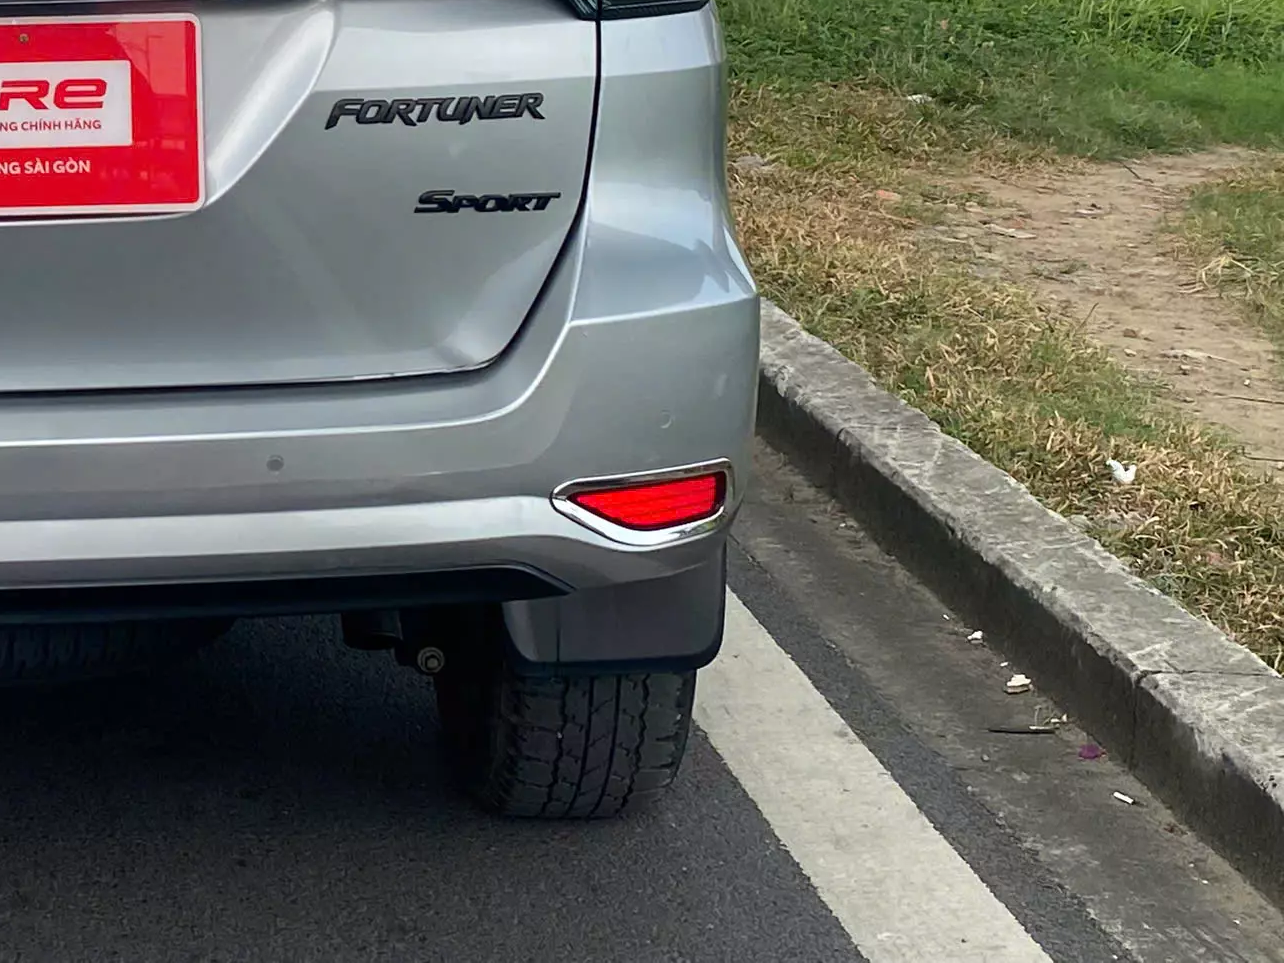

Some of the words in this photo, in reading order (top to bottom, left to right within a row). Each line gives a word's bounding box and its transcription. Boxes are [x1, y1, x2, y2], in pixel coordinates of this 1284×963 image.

[324, 92, 546, 130] FORTUNER
[20, 118, 61, 132] CHÍNH
[64, 118, 102, 131] HÃNG
[24, 157, 50, 174] SÀI
[52, 156, 91, 174] GÒN
